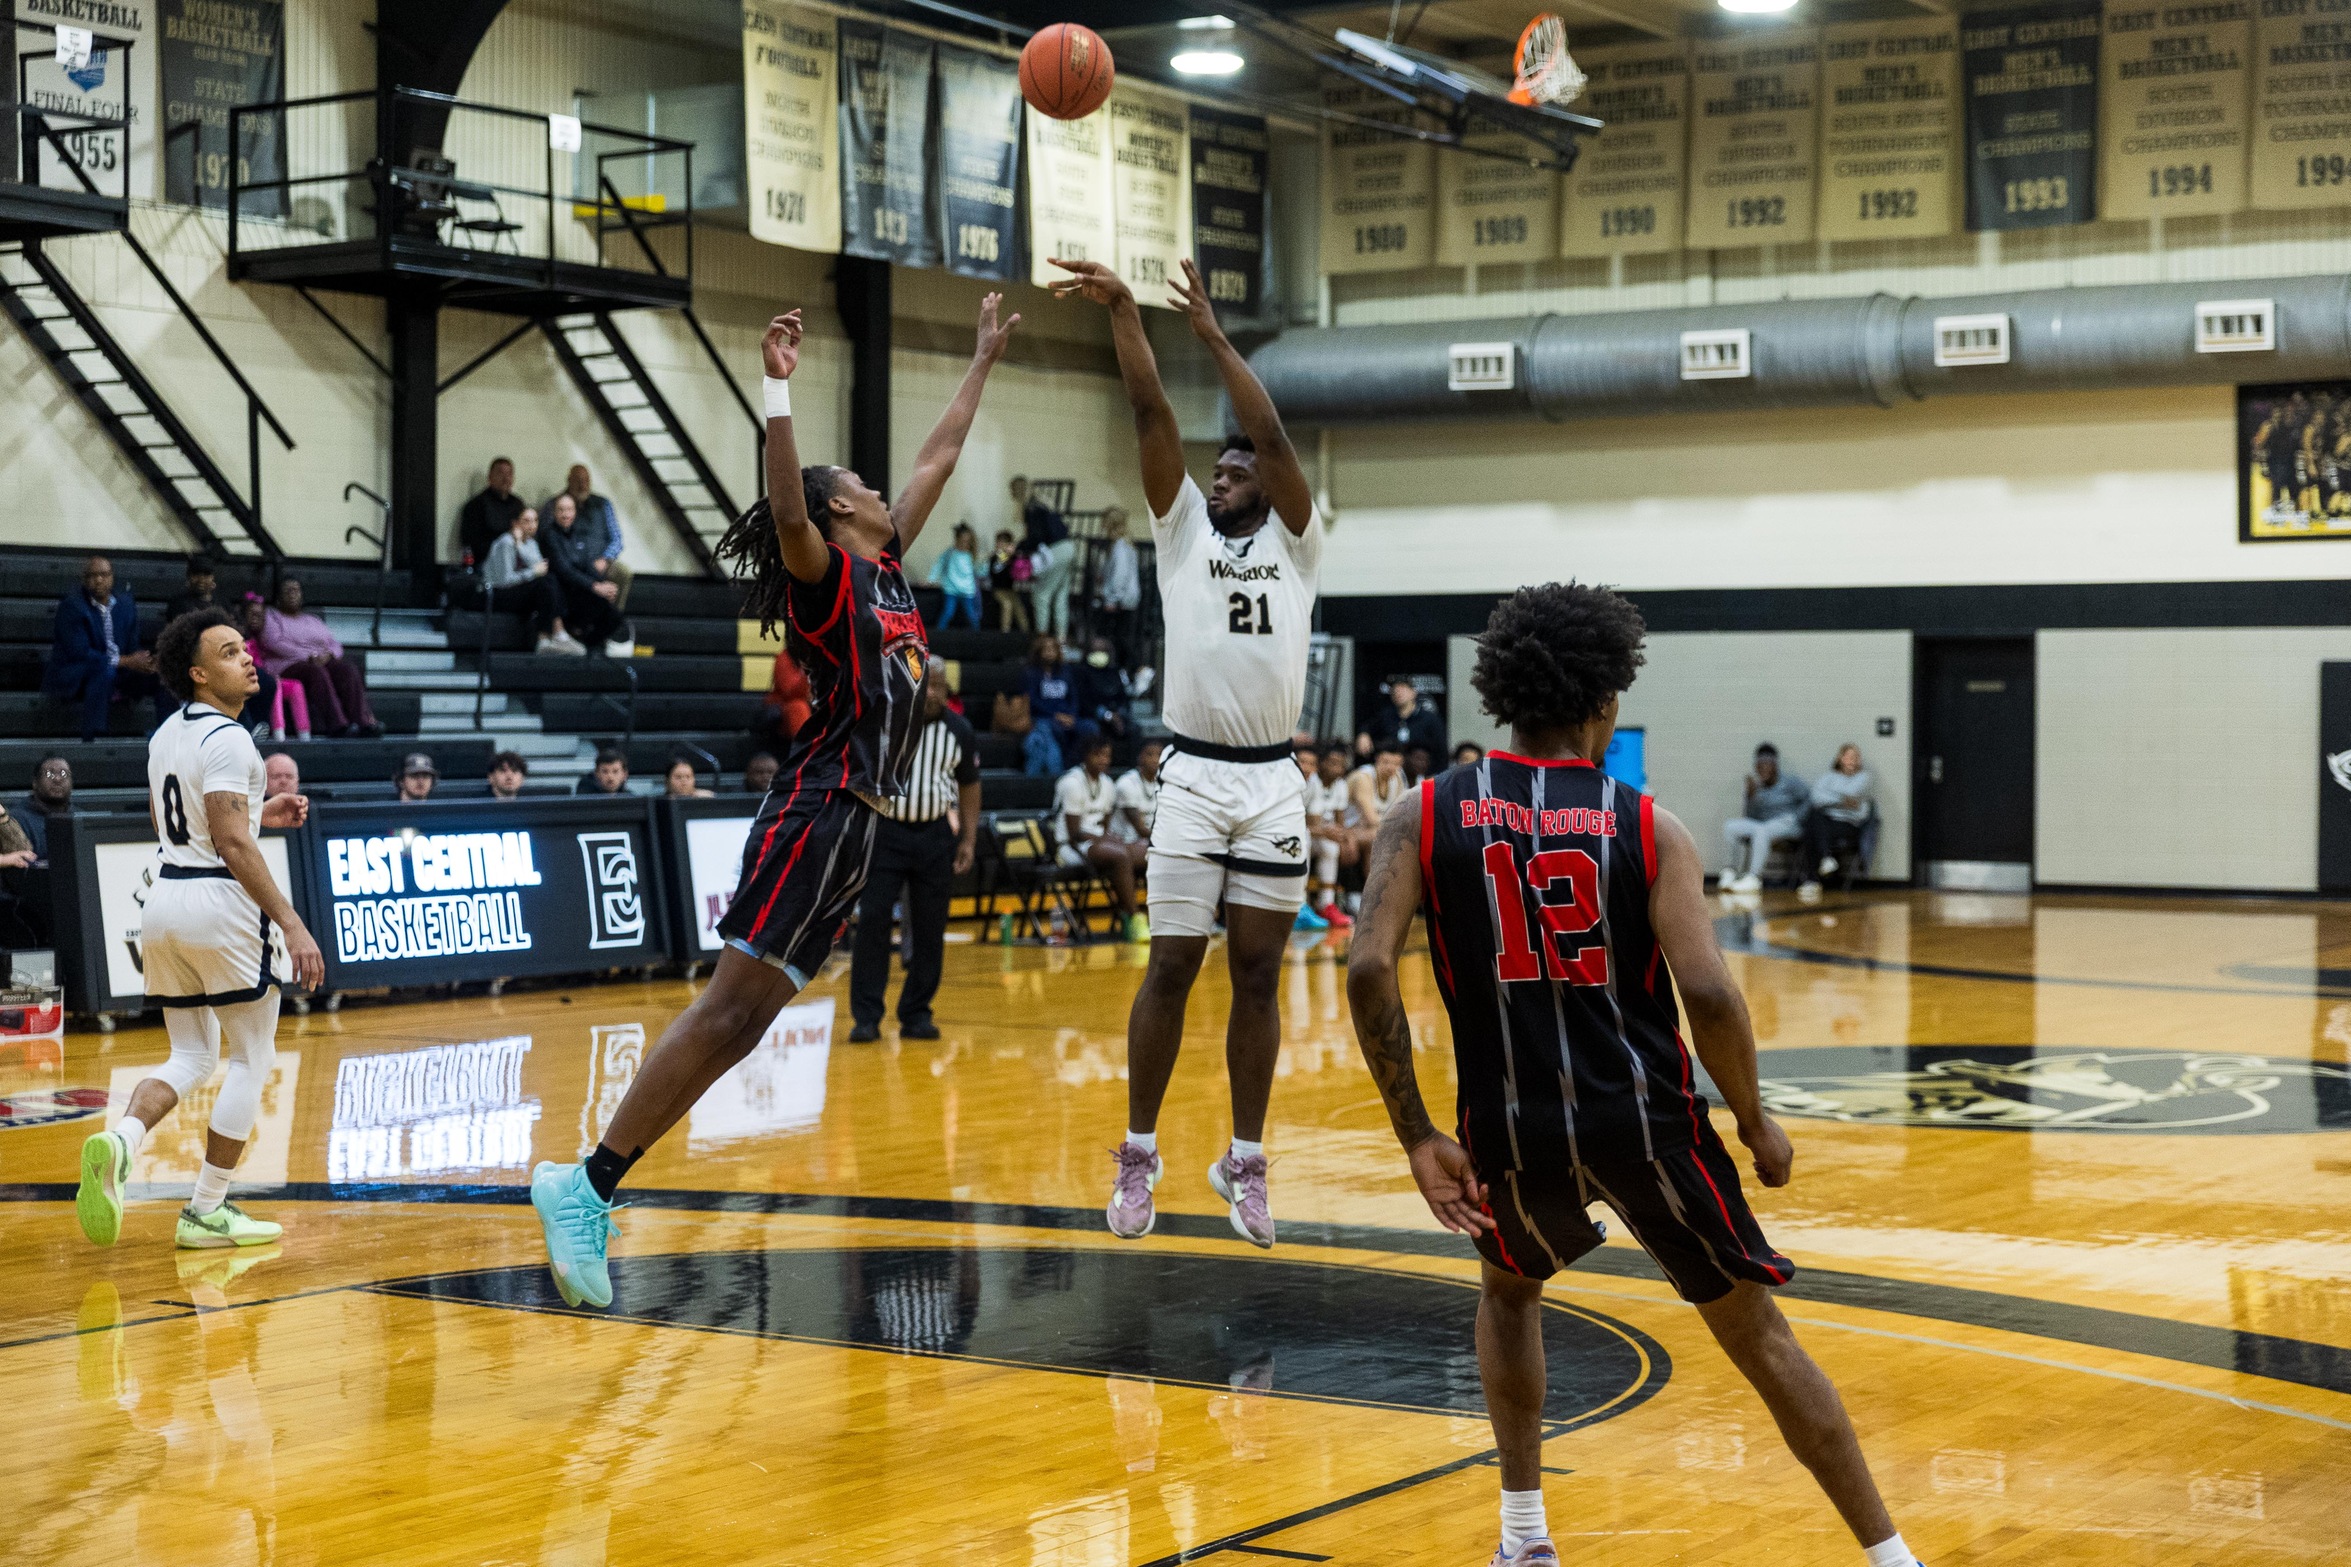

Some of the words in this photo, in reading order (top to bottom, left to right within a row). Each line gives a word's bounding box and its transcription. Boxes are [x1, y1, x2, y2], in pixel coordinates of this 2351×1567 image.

[1229, 591, 1273, 634] 21
[162, 773, 191, 846] 0
[1460, 797, 1534, 835] BATON
[1539, 808, 1617, 837] ROUGE
[327, 837, 405, 896] EAST
[411, 831, 542, 892] CENTRAL
[334, 891, 532, 963] BASKETBALL
[1482, 840, 1610, 986] 12
